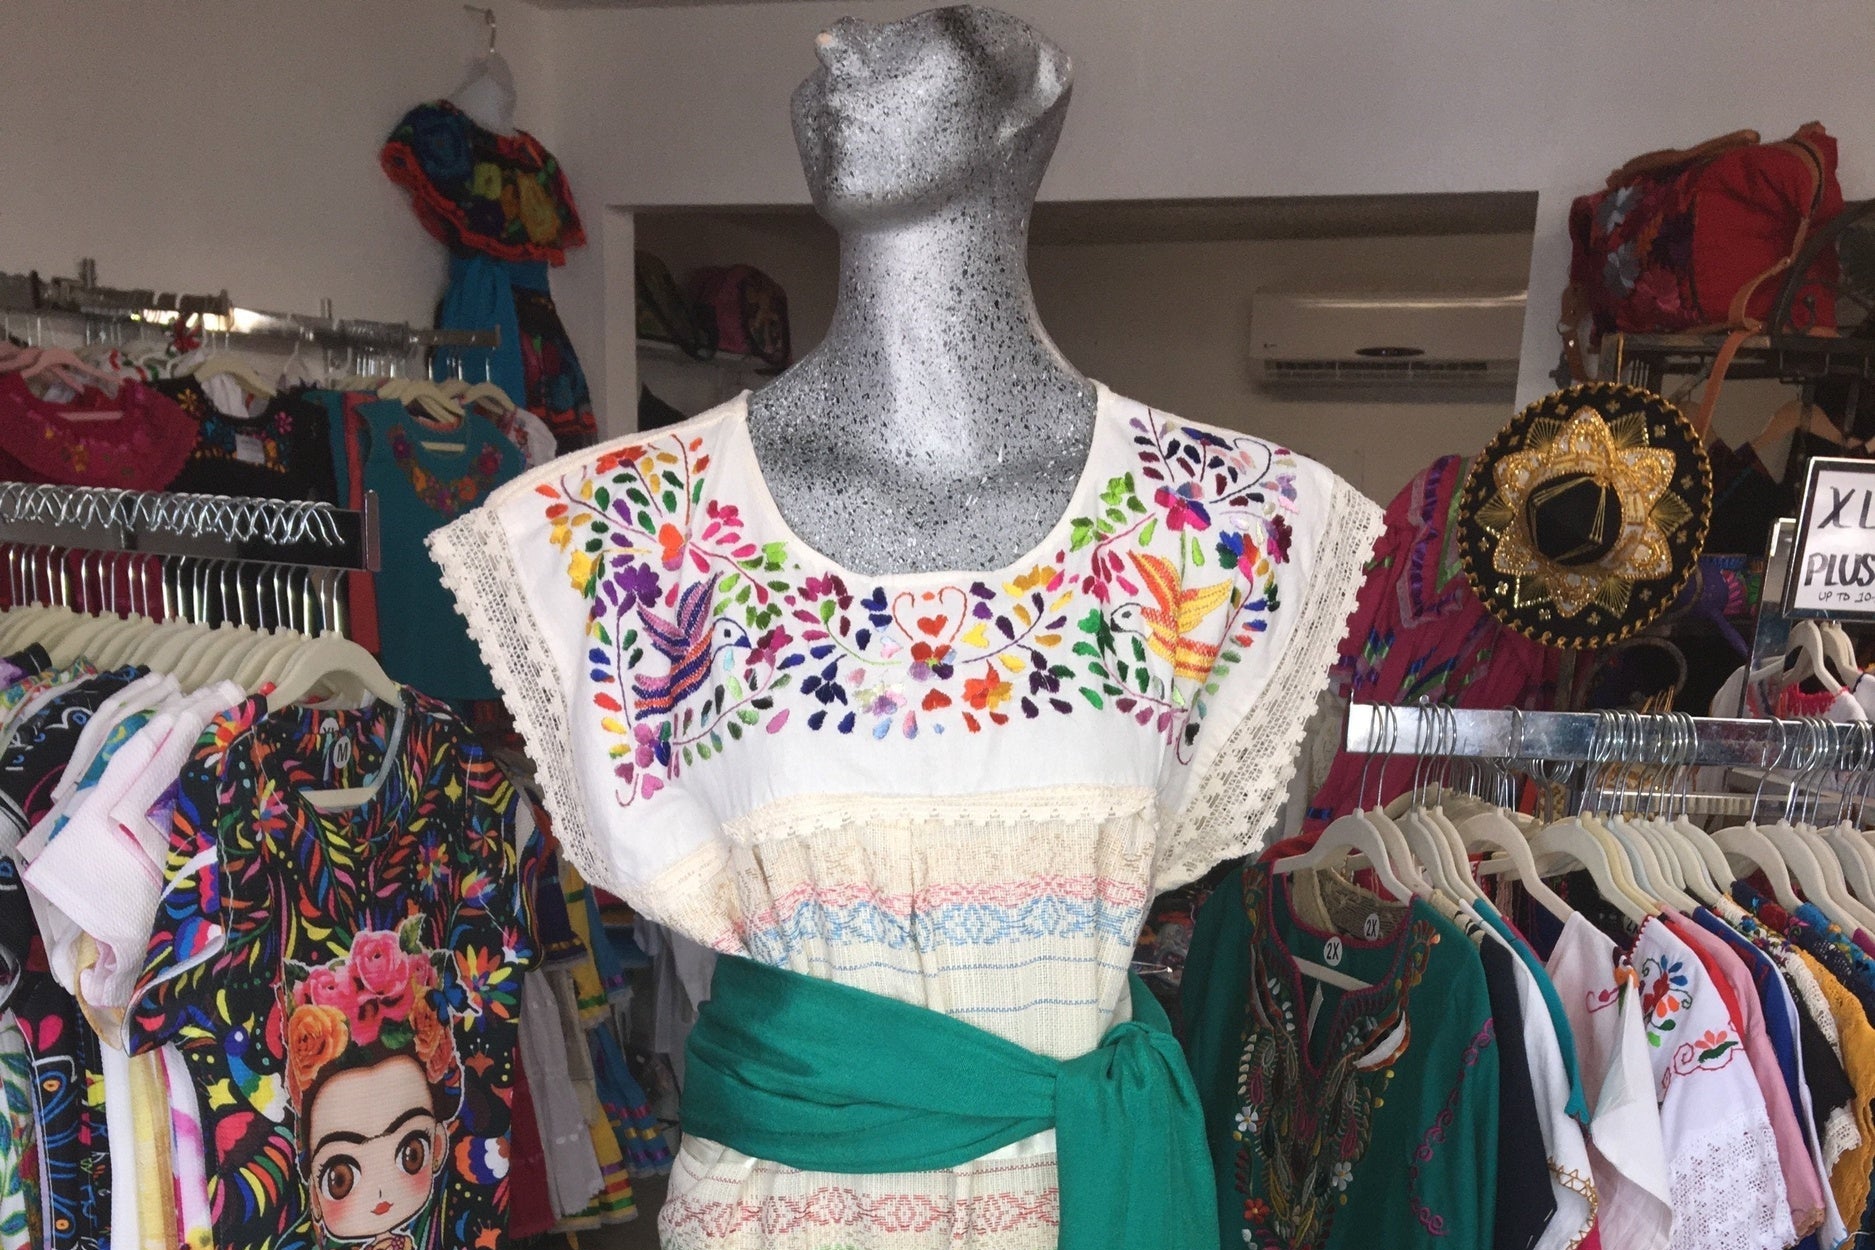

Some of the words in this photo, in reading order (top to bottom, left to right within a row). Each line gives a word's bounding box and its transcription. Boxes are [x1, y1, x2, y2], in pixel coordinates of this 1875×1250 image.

[1817, 485, 1875, 529] XL
[1804, 552, 1875, 587] PLUS
[1818, 591, 1833, 602] UP
[1837, 592, 1850, 601] TO
[337, 742, 348, 762] M
[1366, 919, 1377, 937] 2X
[1326, 942, 1340, 960] 2X
